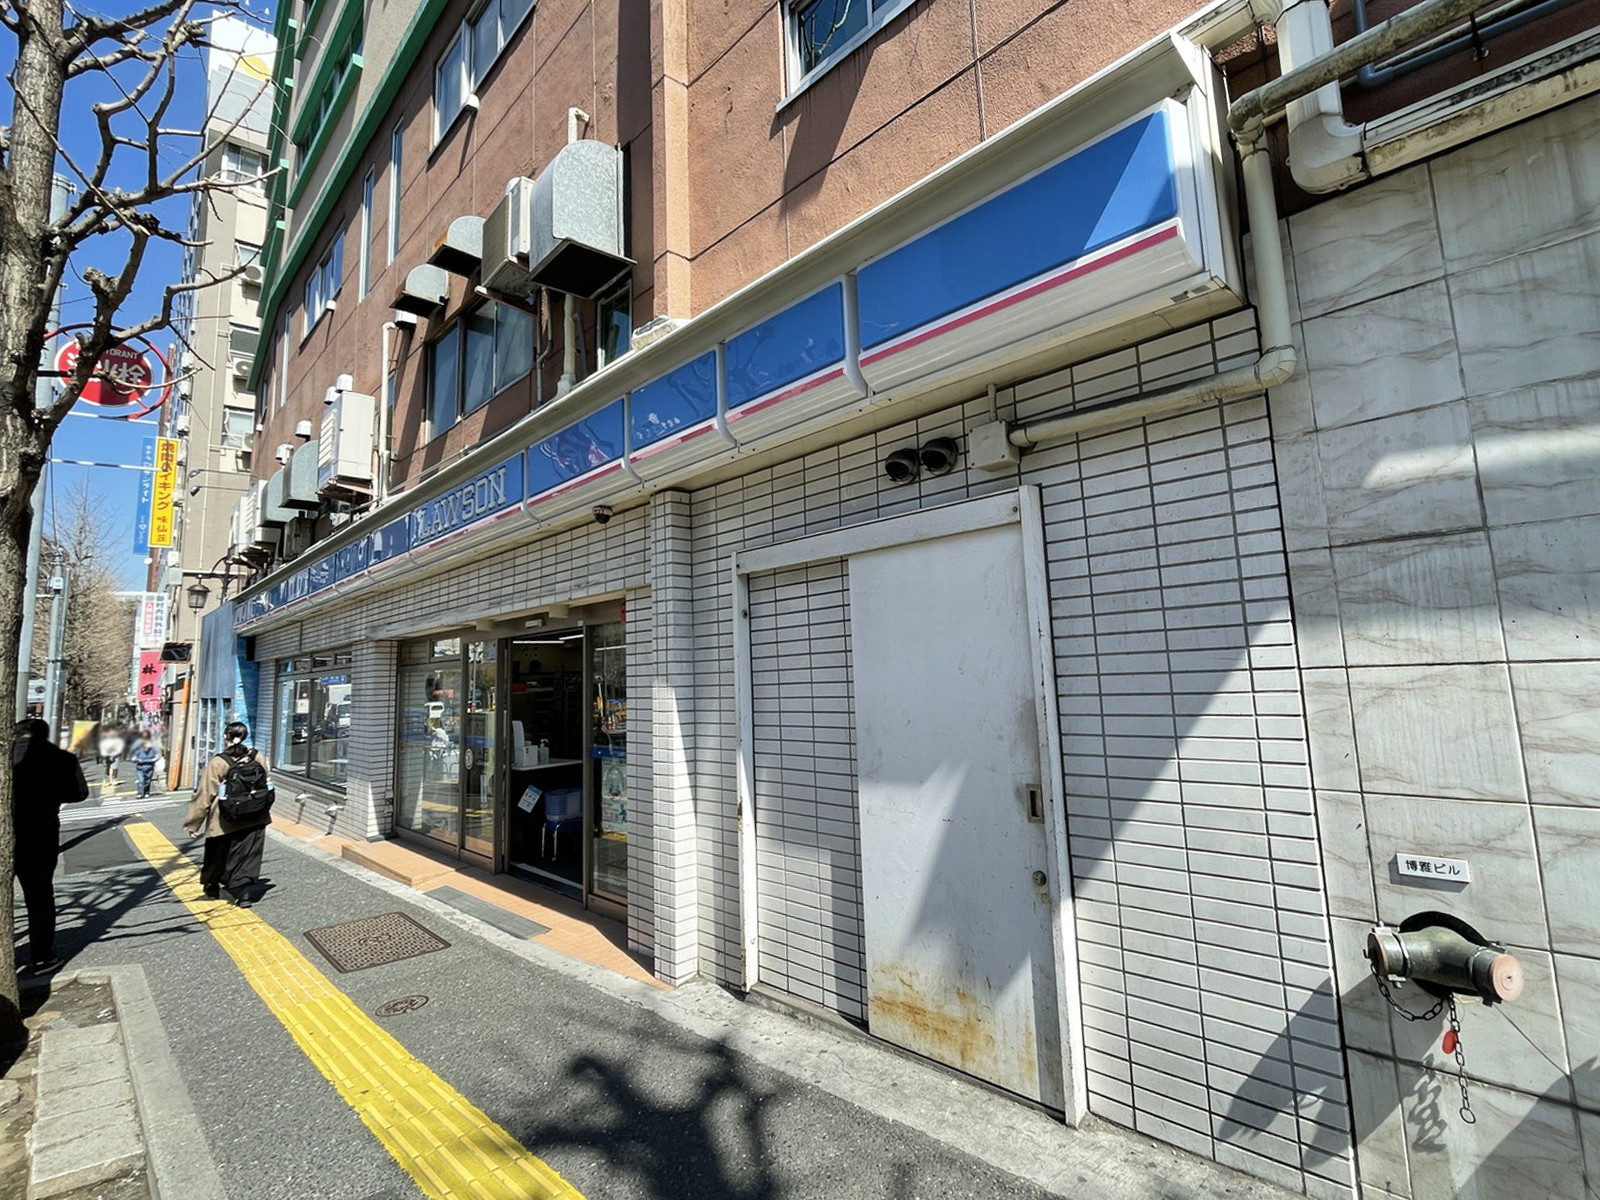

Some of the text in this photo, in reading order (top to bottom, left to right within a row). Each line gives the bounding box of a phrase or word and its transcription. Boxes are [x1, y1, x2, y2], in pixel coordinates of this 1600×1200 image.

[105, 347, 139, 360] DRANT
[418, 465, 507, 540] LAWSON
[1405, 859, 1461, 876] 博雅ビル
